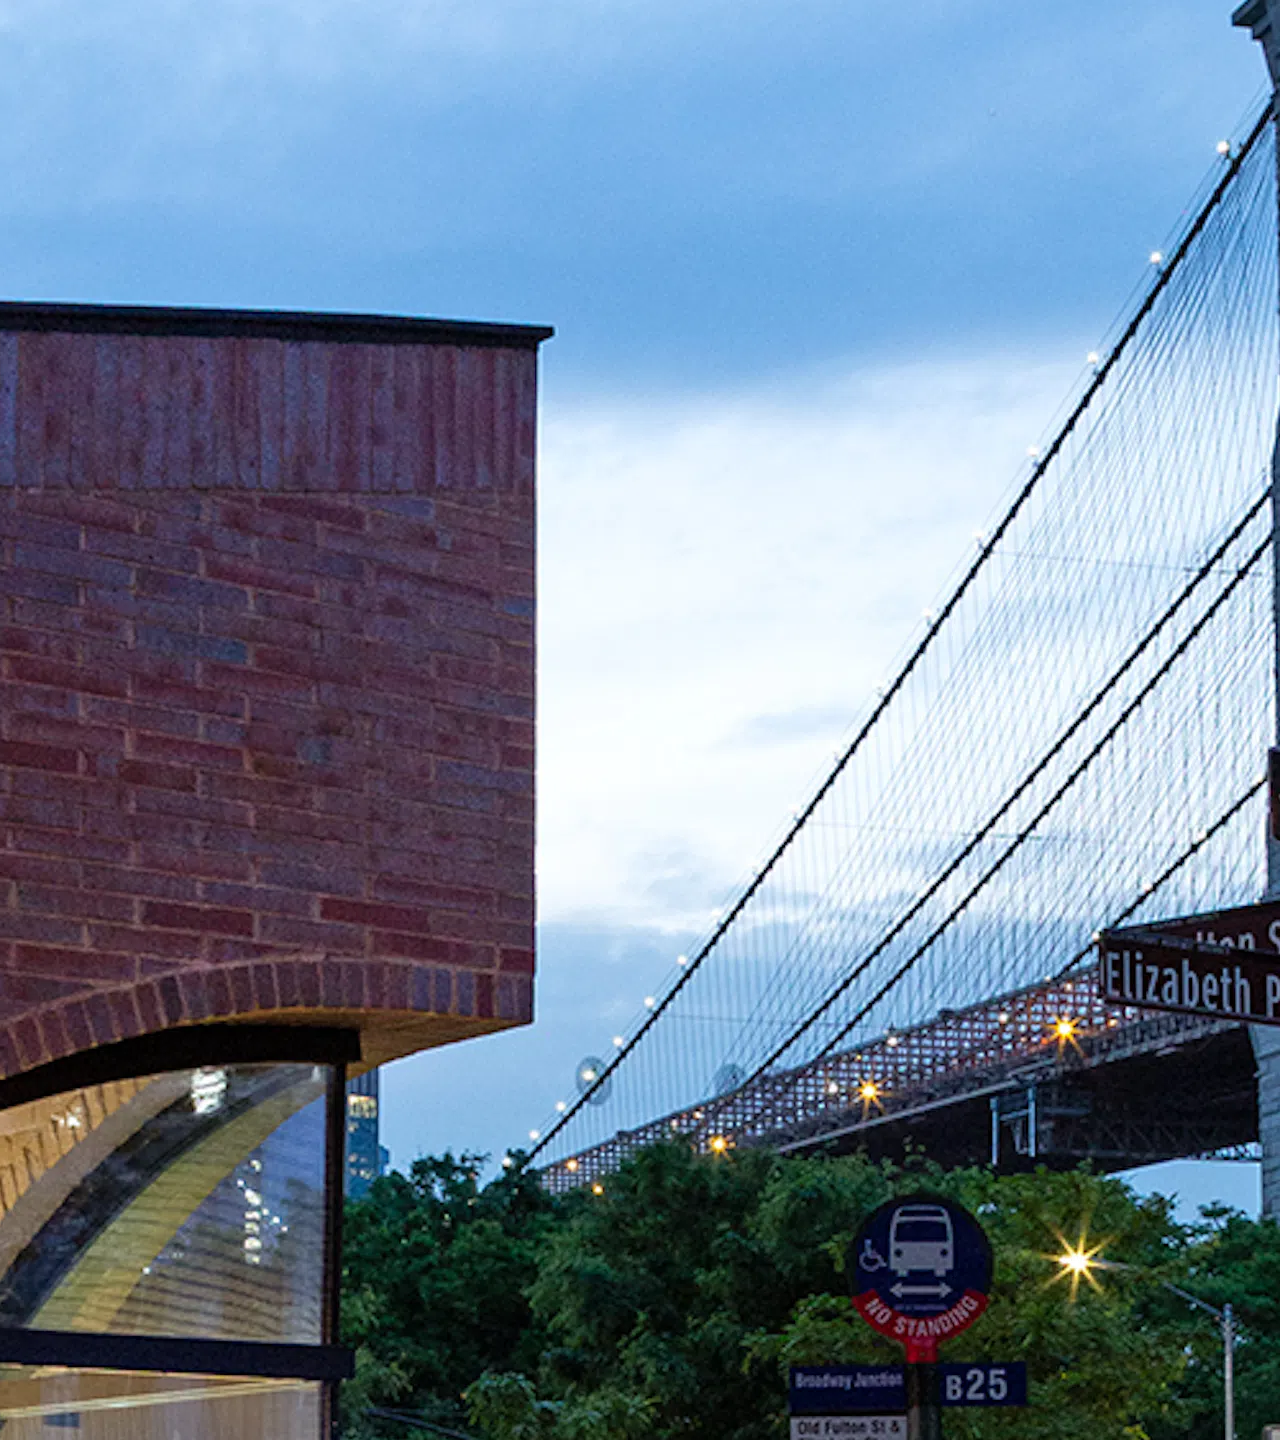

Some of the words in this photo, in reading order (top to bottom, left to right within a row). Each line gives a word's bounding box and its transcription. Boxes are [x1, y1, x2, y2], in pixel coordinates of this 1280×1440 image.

[1106, 949, 1251, 1016] Elizabeth
[864, 1298, 892, 1325] NO
[893, 1295, 979, 1337] STANDING
[795, 1371, 853, 1391] Broadway
[854, 1371, 903, 1388] Junction
[945, 1368, 1008, 1401] B25
[798, 1420, 820, 1435] Old
